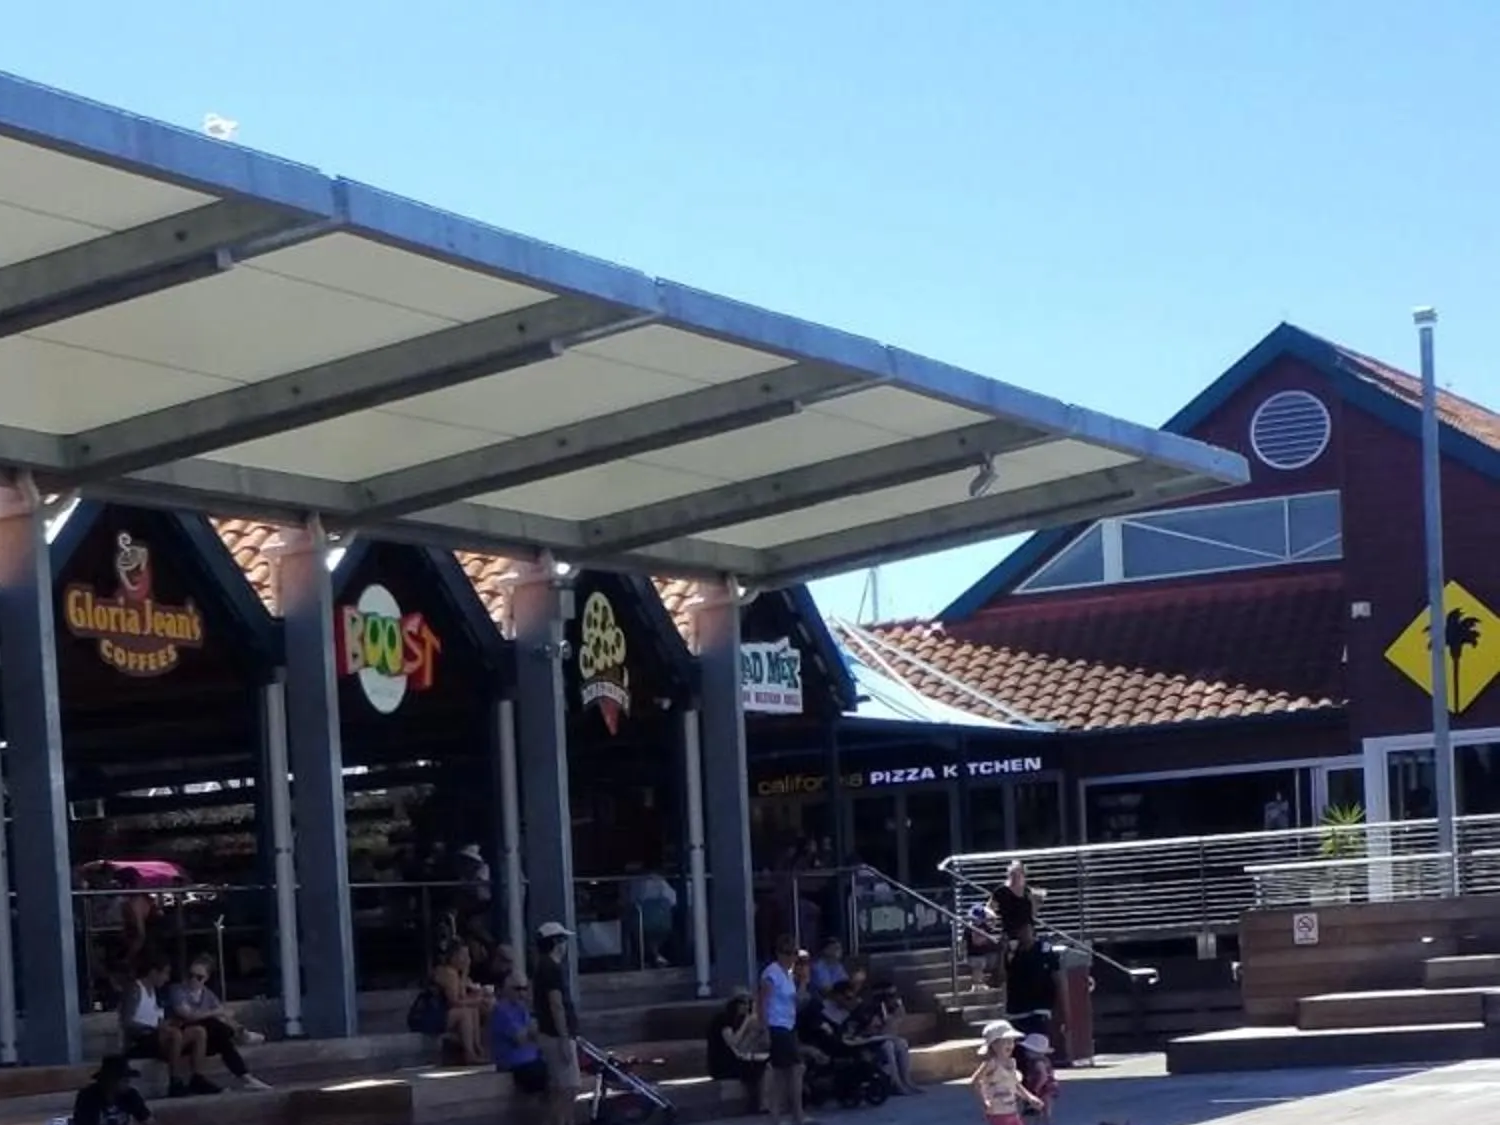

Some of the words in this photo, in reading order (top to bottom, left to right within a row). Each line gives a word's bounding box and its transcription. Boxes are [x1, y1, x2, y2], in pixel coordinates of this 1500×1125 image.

[68, 589, 140, 635] Gloria
[140, 598, 202, 640] Jean's
[100, 639, 178, 672] COFFEES
[342, 603, 442, 688] BOOST
[740, 651, 763, 685] AD
[869, 767, 936, 785] PIZZA
[943, 756, 1042, 778] KTCHEN
